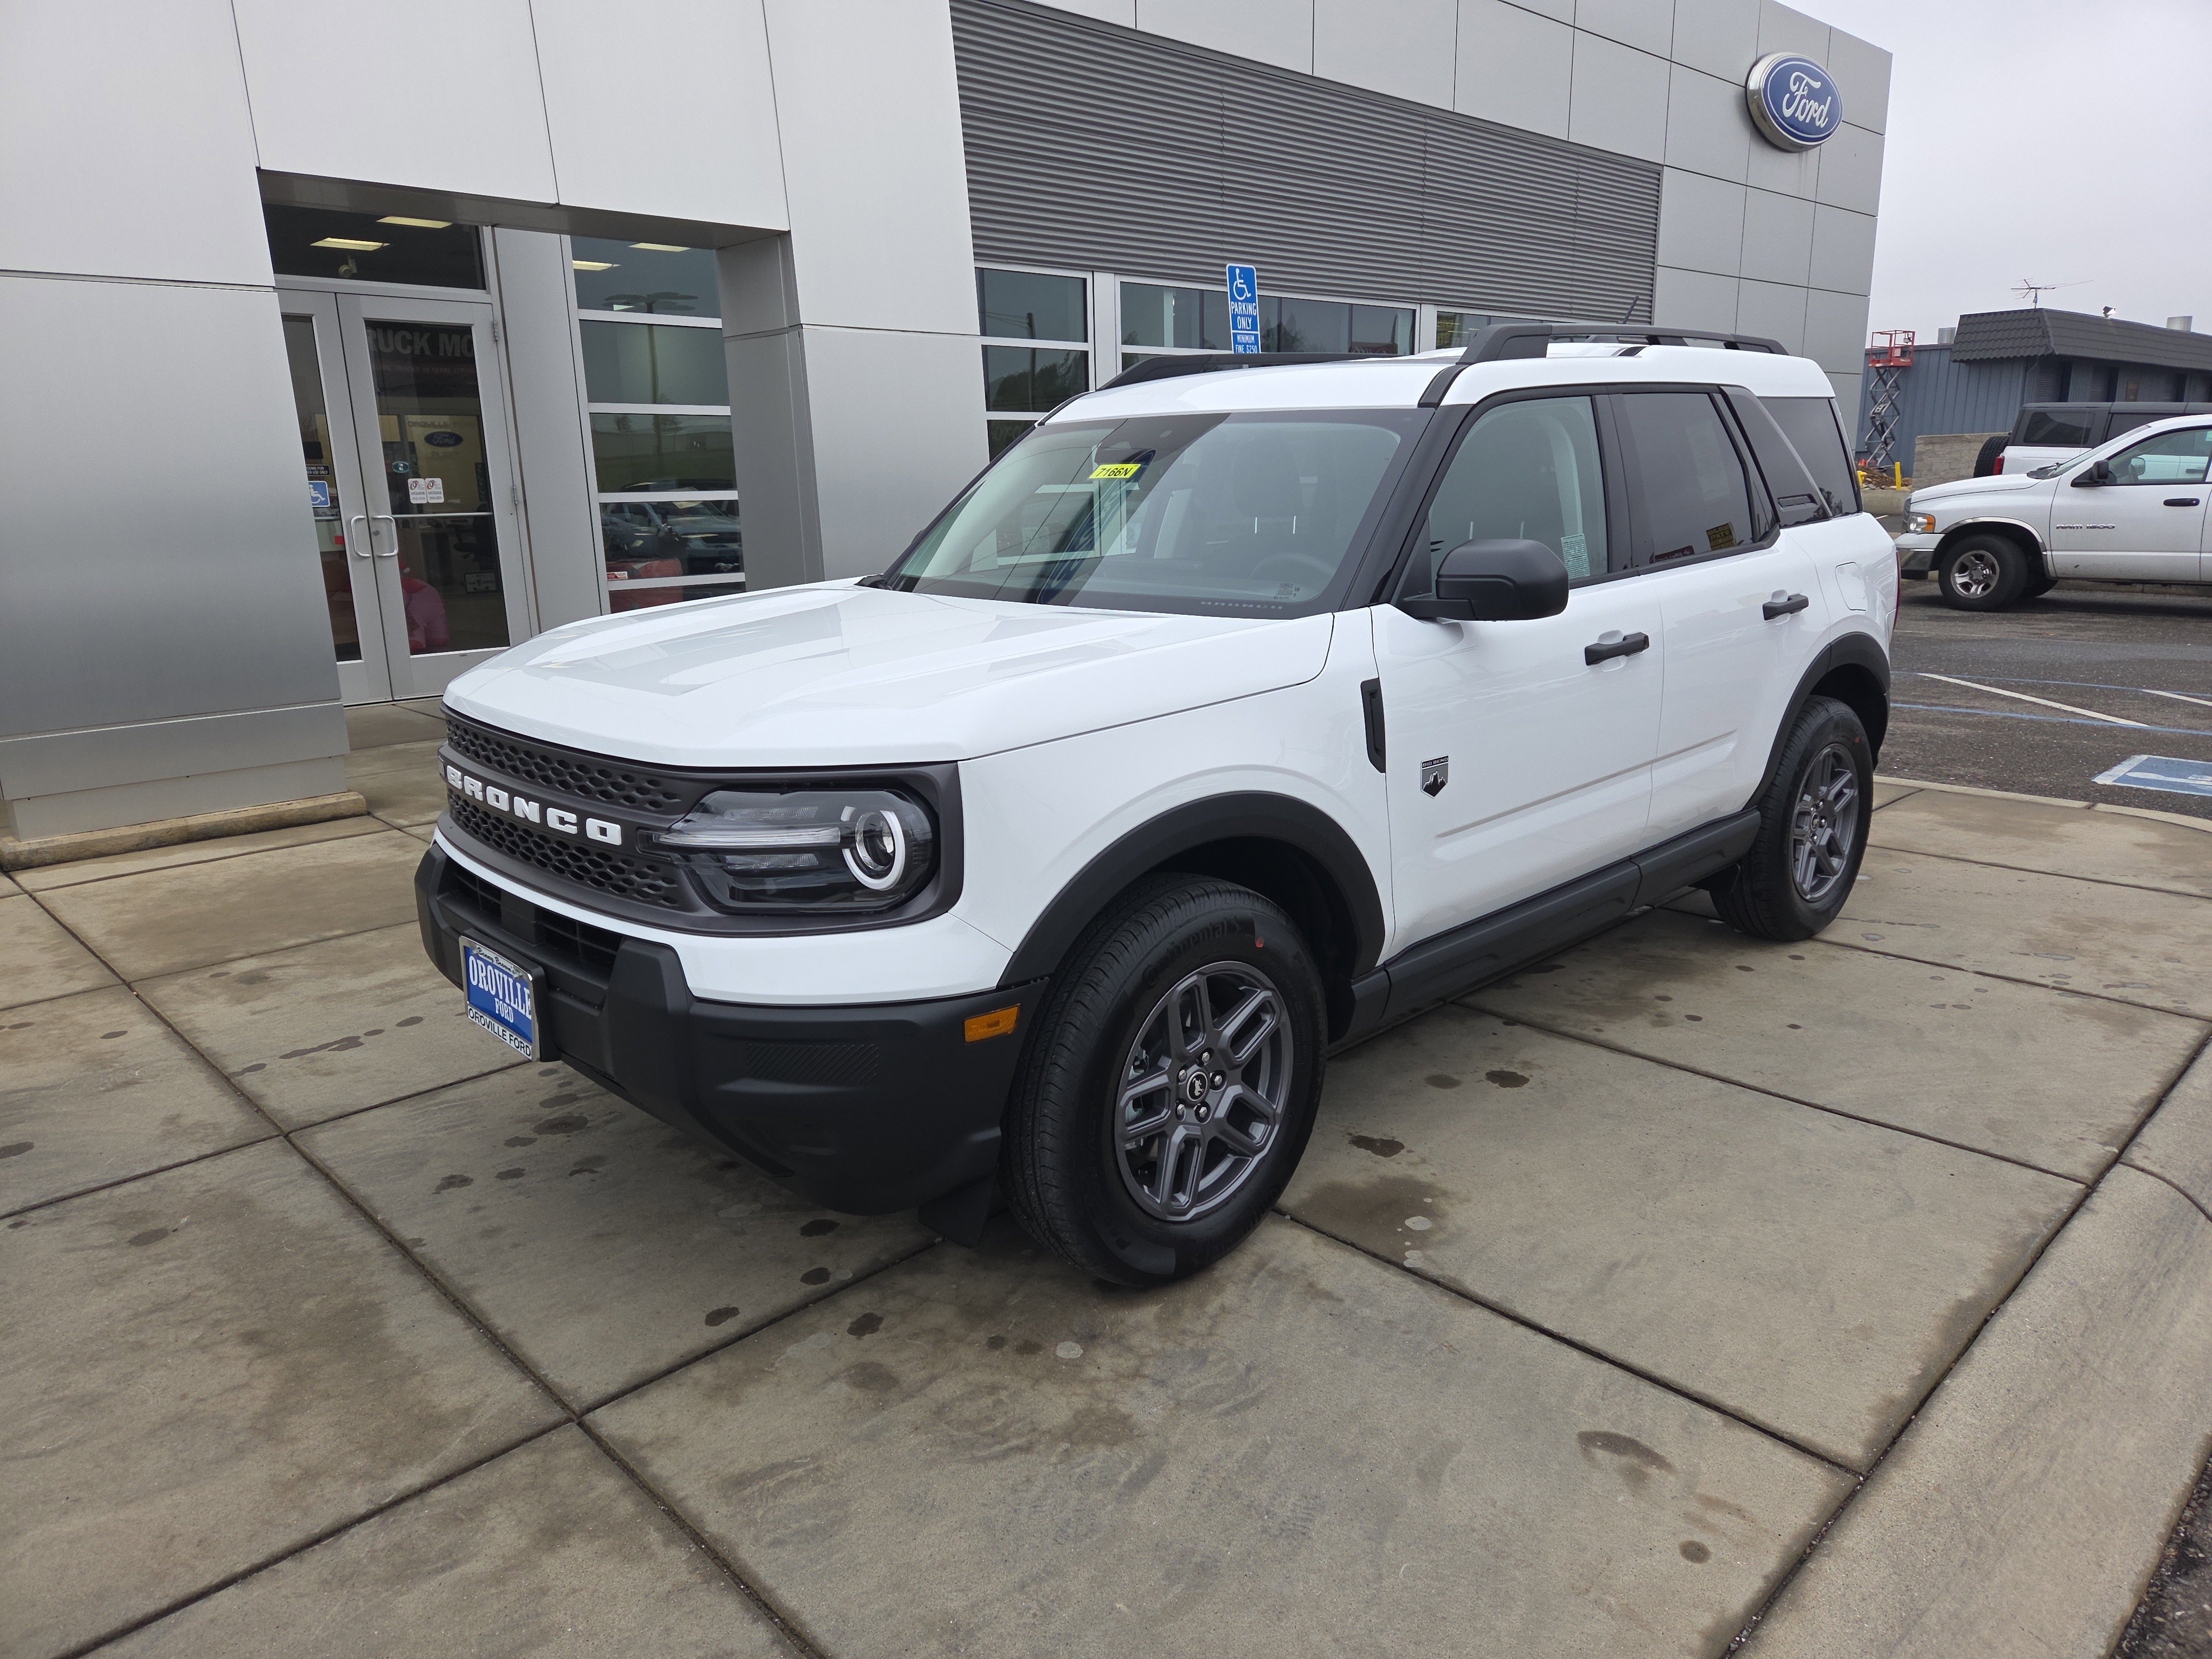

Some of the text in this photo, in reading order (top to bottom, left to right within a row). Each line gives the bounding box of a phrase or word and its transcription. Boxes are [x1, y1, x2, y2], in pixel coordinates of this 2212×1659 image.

[1782, 72, 1831, 128] Ford
[1231, 301, 1257, 316] PARKING
[1237, 316, 1252, 330] ONLY
[1096, 467, 1133, 477] 7166N
[446, 764, 622, 846] BRONCO
[468, 955, 532, 1020] OROVILLE
[494, 998, 514, 1023] FORD
[468, 1008, 531, 1057] OROVILLE FORD
